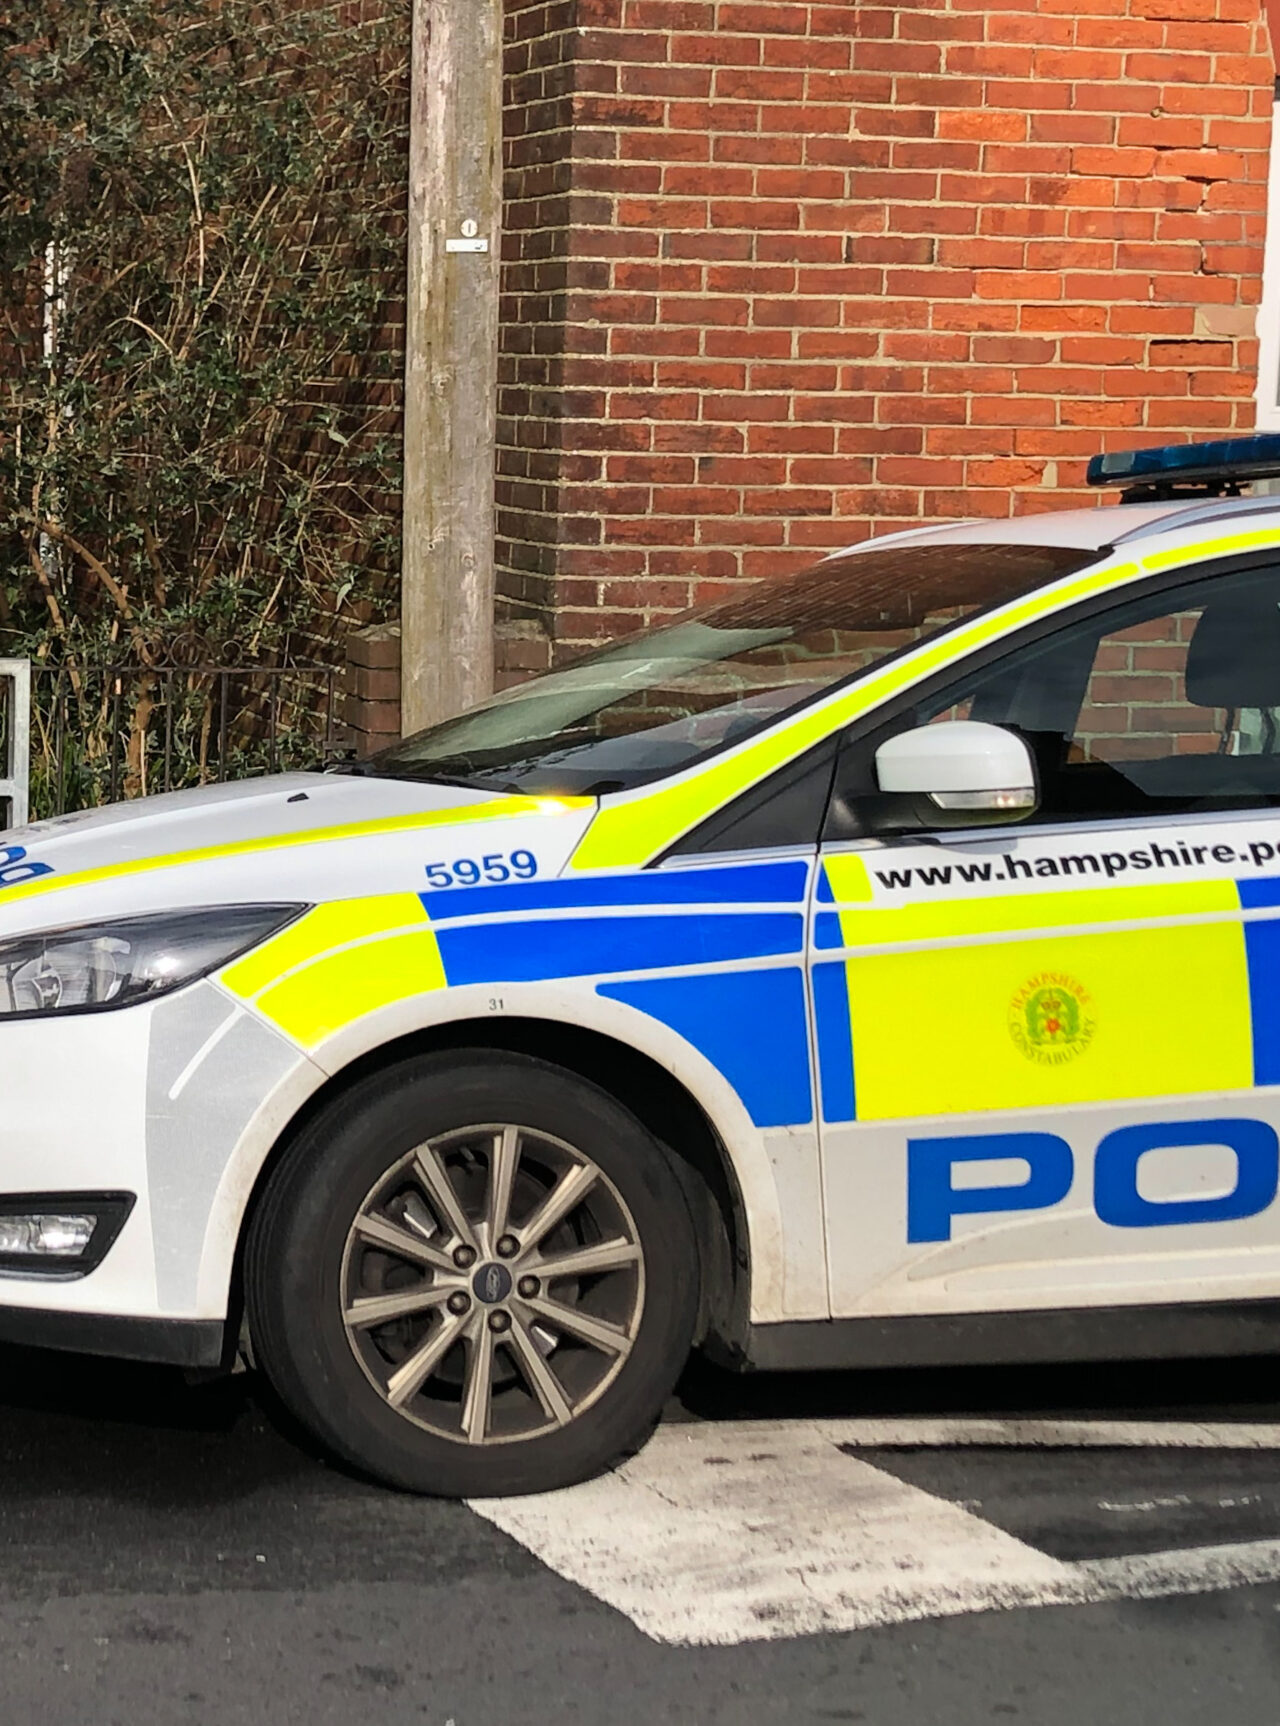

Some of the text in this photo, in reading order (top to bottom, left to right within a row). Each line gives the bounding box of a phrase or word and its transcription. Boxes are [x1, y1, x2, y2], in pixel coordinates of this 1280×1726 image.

[424, 849, 538, 888] 5959
[874, 840, 1280, 890] www.hampshire.p
[488, 998, 504, 1011] 31
[906, 1117, 1280, 1245] PO
